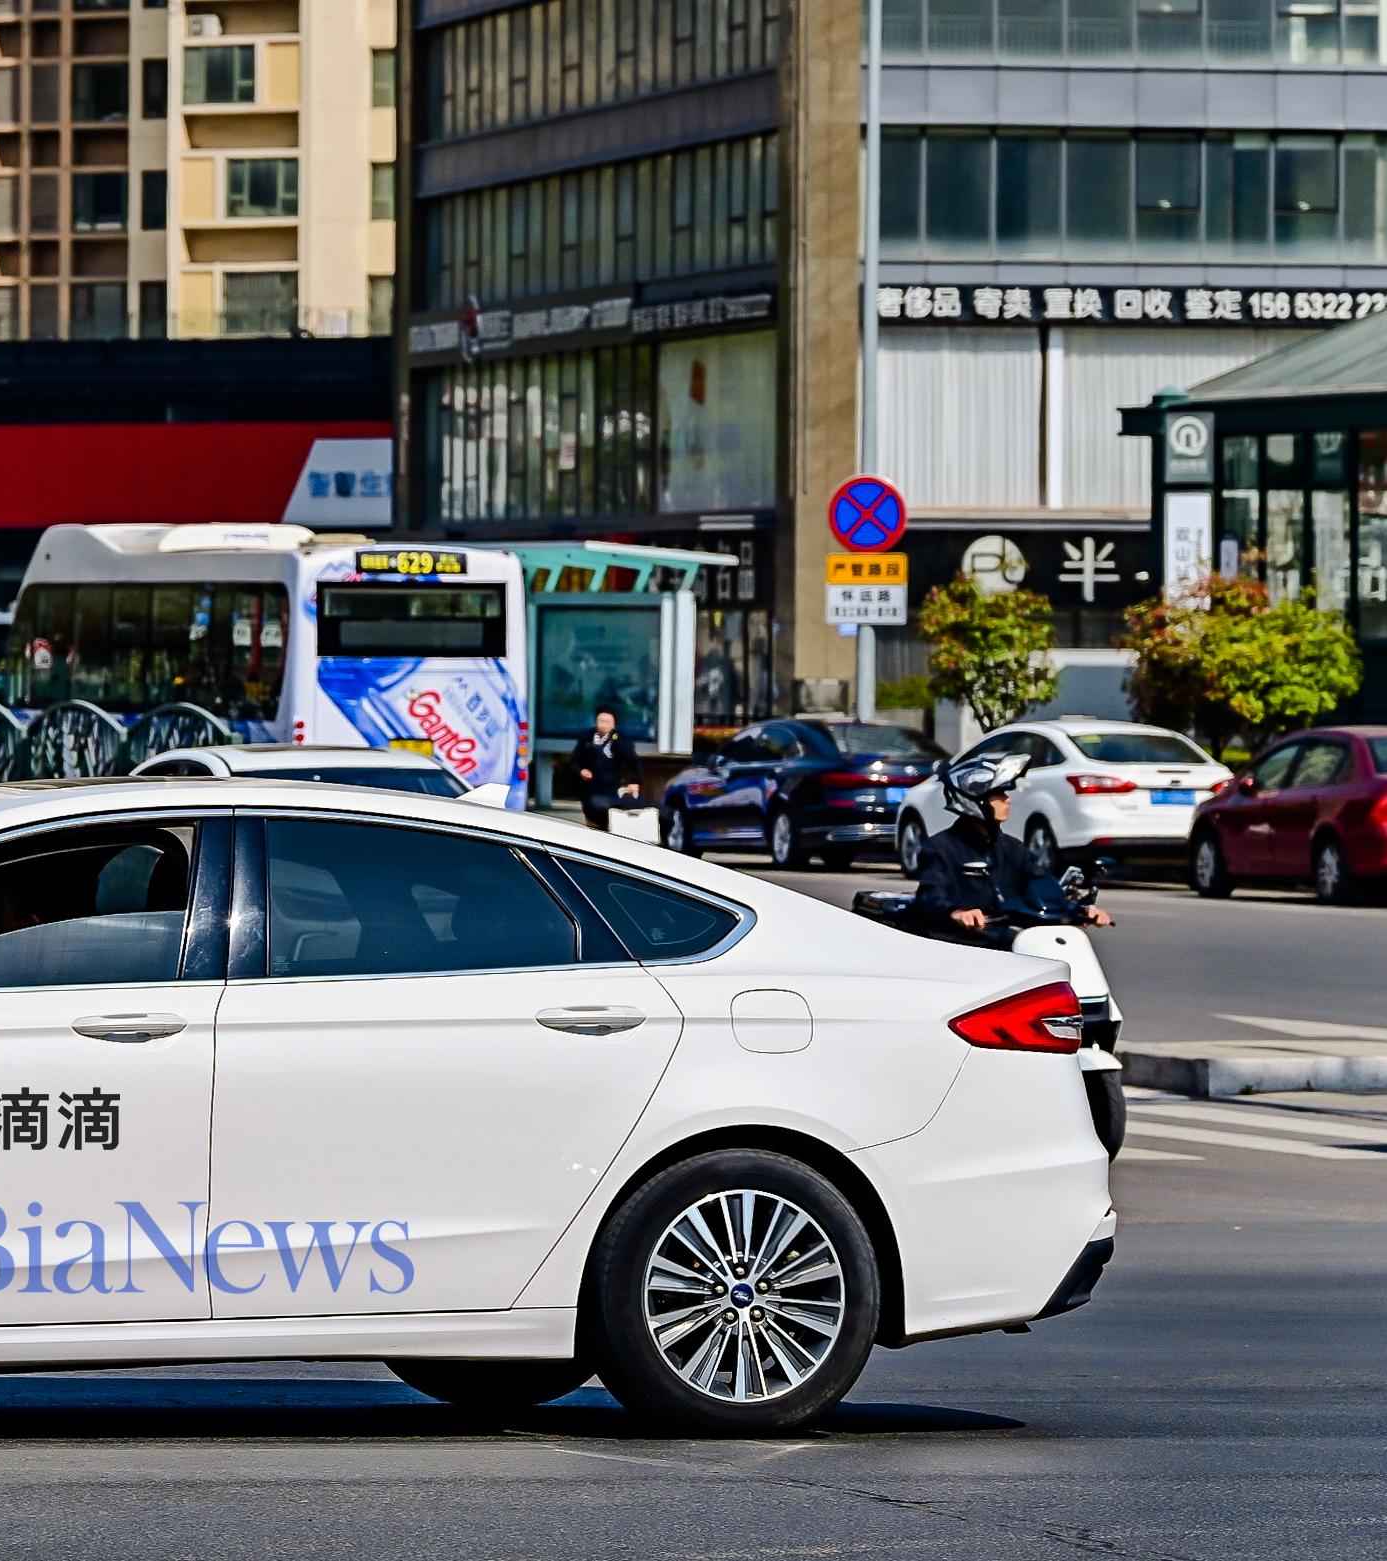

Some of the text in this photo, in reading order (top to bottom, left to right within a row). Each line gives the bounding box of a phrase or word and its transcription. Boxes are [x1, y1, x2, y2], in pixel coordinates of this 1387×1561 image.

[1044, 287, 1103, 319] 置换
[1115, 289, 1173, 319] 回收
[1294, 291, 1353, 320] 5322
[307, 471, 392, 498] 智慧生
[397, 551, 434, 574] 629
[833, 563, 900, 577] 严管路段
